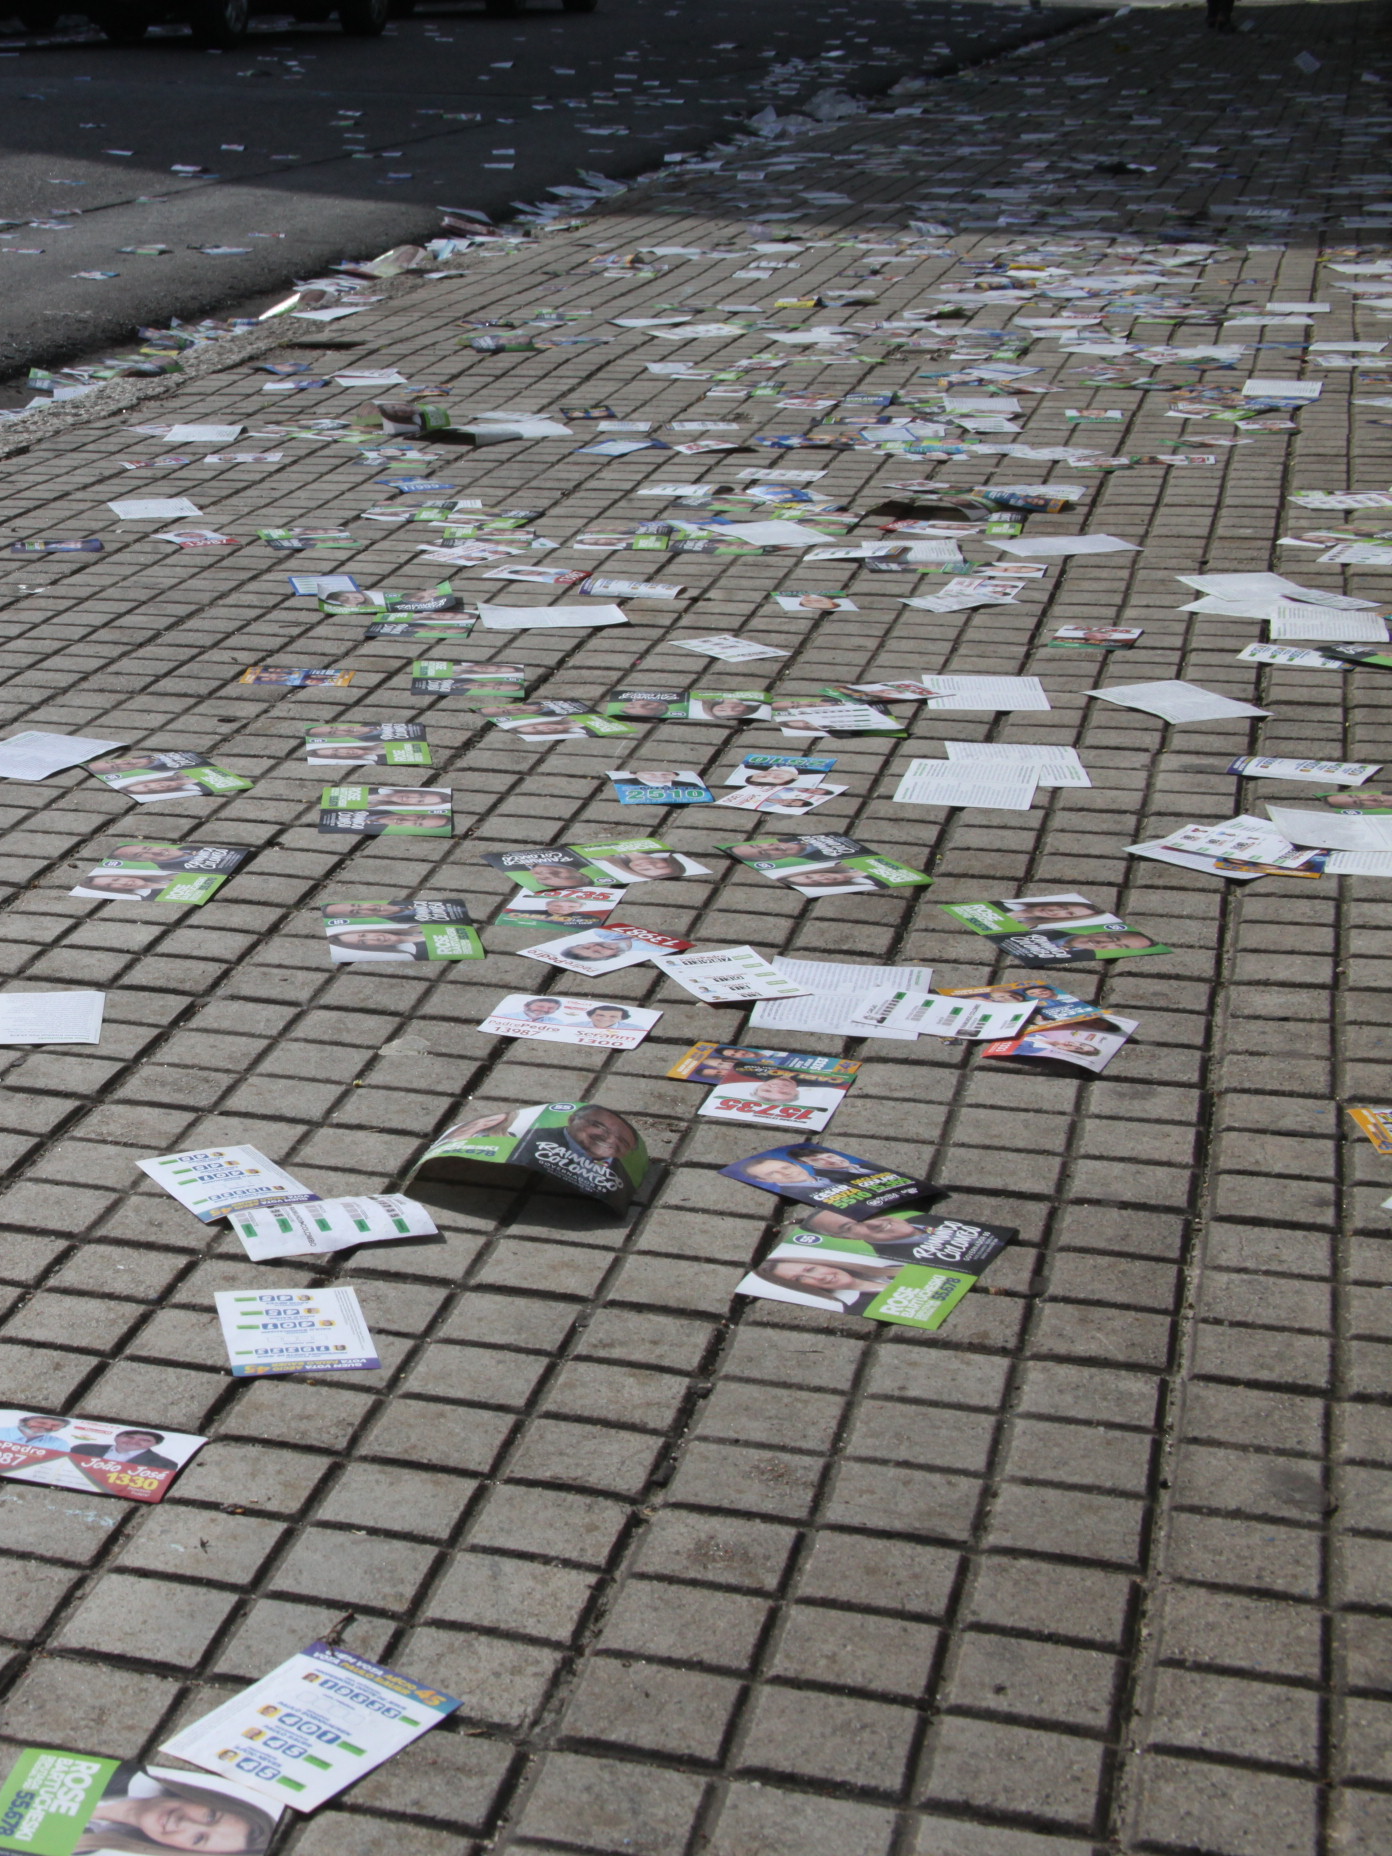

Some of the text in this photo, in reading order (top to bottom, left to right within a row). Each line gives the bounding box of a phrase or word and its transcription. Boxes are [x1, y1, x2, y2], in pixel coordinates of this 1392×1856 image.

[748, 756, 828, 766] 2510
[625, 789, 705, 800] 2510
[972, 904, 1005, 921] ROSE
[433, 935, 451, 955] ROSE
[612, 926, 680, 946] 13987
[488, 1019, 560, 1032] PadrePedro
[494, 1026, 540, 1037] 13987
[576, 1029, 637, 1042] Serafim
[577, 1037, 624, 1048] 1300
[715, 1098, 813, 1120] 15735
[535, 1151, 618, 1191] COLOMBO
[536, 1141, 623, 1189] RAIMUNDO
[538, 1160, 596, 1188] GOVERNADOR
[813, 1184, 852, 1200] CESAR
[832, 1191, 874, 1209] 5510
[800, 1235, 815, 1244] 55
[913, 1220, 963, 1260] RAIMUNDO
[937, 1223, 982, 1262] COLOMBO
[879, 1285, 915, 1315] ROSE
[901, 1275, 946, 1318] BARTUCHESKI
[931, 1277, 962, 1302] 55.678
[244, 1365, 271, 1374] 45
[81, 1457, 169, 1480] João José
[106, 1472, 159, 1491] 1330
[313, 1651, 412, 1697] VOTA PAULO BAUER
[356, 1659, 417, 1691] VOTA AÉCIO
[415, 1689, 448, 1708] 45
[277, 1712, 341, 1745] 401
[262, 1735, 308, 1760] 45
[235, 1757, 281, 1781] 45
[14, 1757, 75, 1841] BARTUCHESKI
[49, 1760, 101, 1816] ROSE
